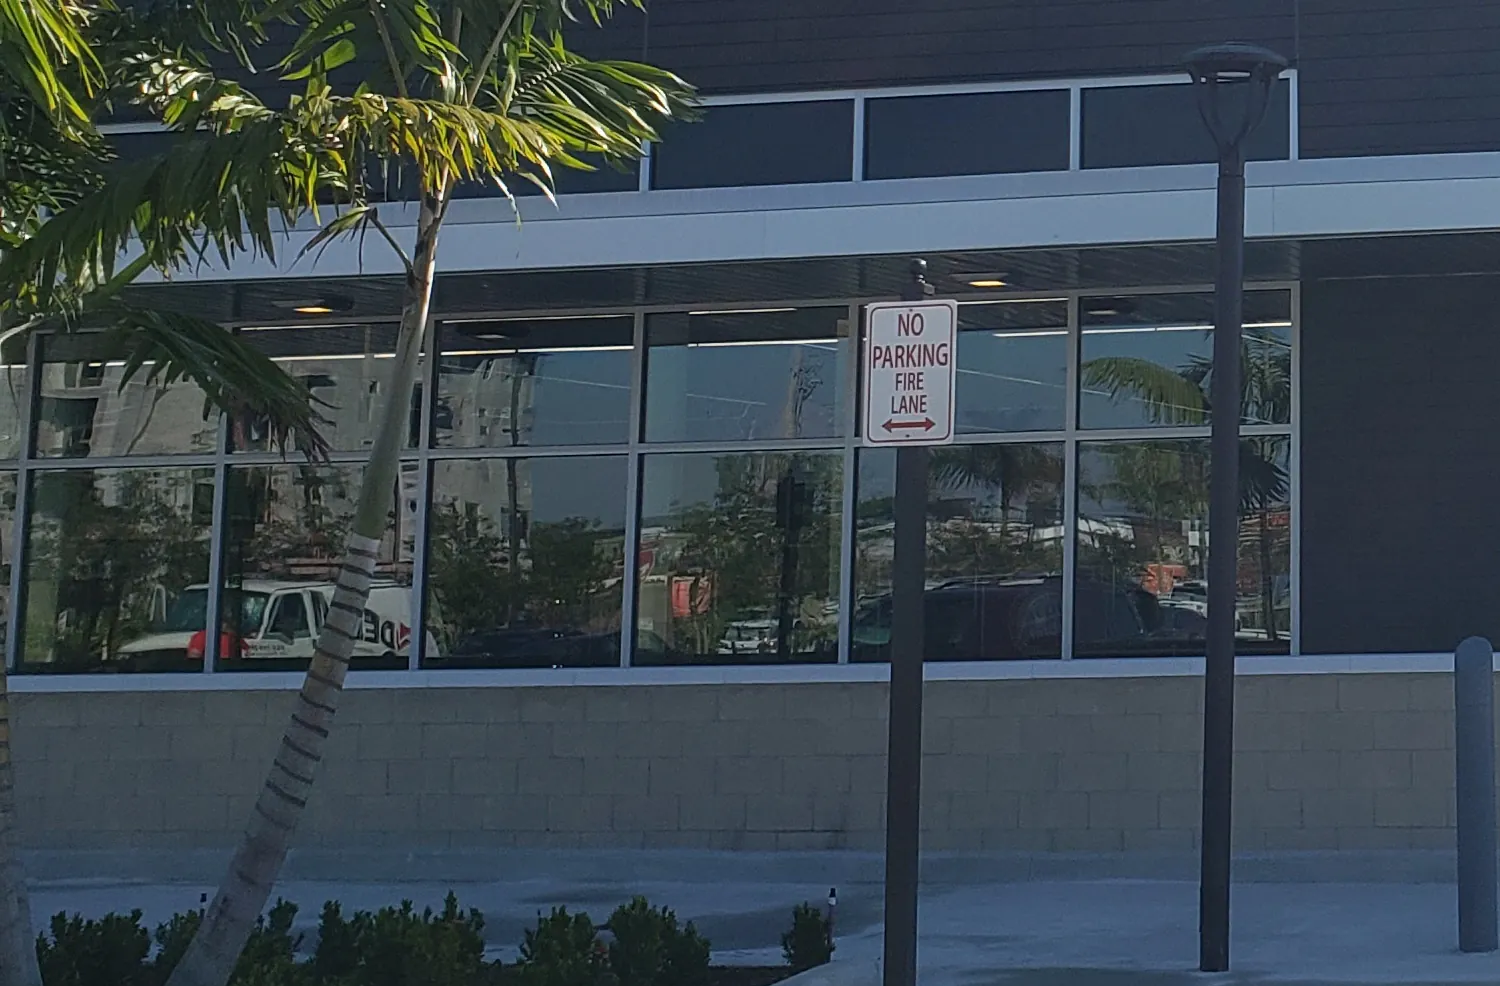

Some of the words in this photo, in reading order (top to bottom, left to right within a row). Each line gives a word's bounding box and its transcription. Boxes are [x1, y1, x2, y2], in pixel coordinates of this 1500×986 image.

[897, 312, 925, 337] NO
[872, 343, 949, 369] PARKING
[895, 371, 925, 391] FIRE
[891, 394, 928, 414] LANE
